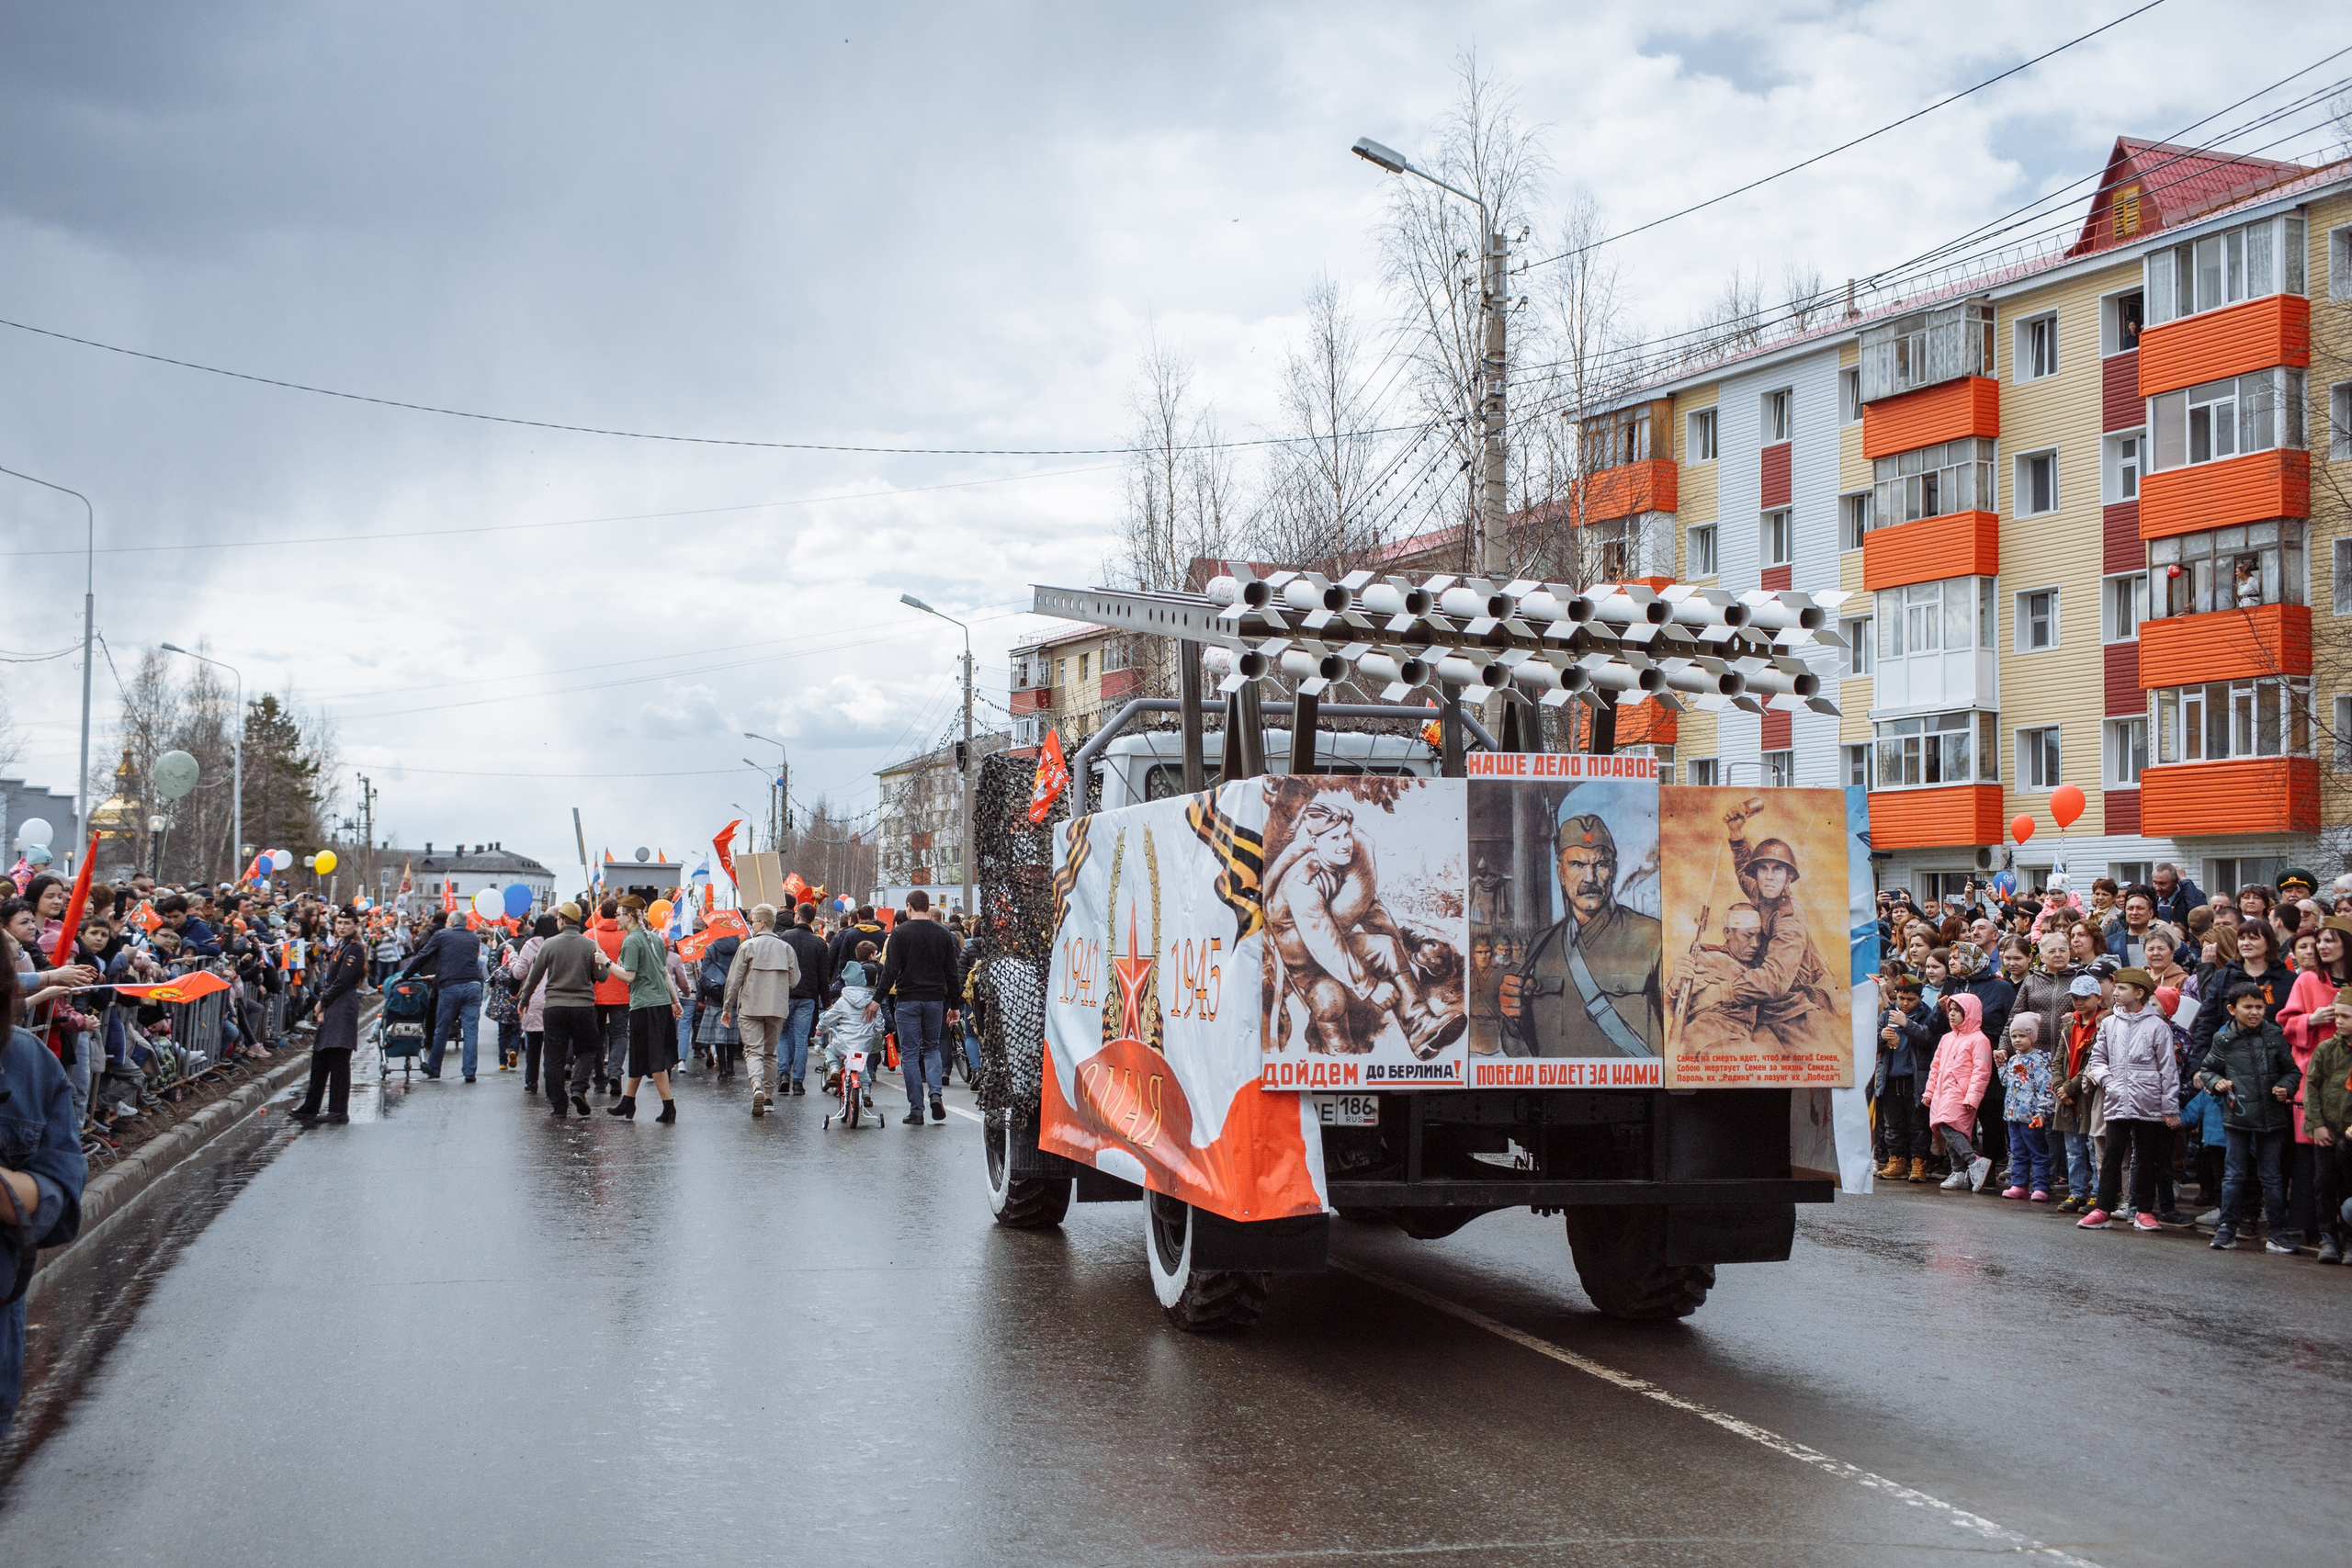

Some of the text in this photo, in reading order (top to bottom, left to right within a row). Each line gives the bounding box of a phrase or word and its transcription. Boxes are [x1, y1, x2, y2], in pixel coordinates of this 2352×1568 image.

[1467, 754, 1658, 778] НАШЕ ДЕЛО ПРАВОЕ
[1058, 937, 1099, 1008] 1941
[1170, 937, 1222, 1022] 1945
[1365, 1065, 1385, 1079] ДО
[1388, 1059, 1461, 1079] БЕРЛИНА!
[1677, 1055, 1699, 1063] Самед
[1712, 1055, 1738, 1064] смерть
[1739, 1055, 1759, 1063] идет,
[1761, 1054, 1780, 1062] чтоб
[1792, 1054, 1814, 1062] погиб
[1815, 1054, 1840, 1063] Семен,
[1677, 1064, 1701, 1072] Собою
[1704, 1064, 1740, 1073] жертвует
[1745, 1064, 1767, 1072] Семен
[1769, 1064, 1778, 1072] за
[1781, 1064, 1804, 1072] жизнь
[1476, 1063, 1660, 1087] ПОБЕДА БУДЕТ ЗА НАМИ
[1677, 1074, 1703, 1082] Пароль
[1706, 1074, 1715, 1082] их
[1764, 1074, 1788, 1083] лозунг
[1791, 1074, 1800, 1082] их
[1081, 1062, 1163, 1149] 9 МАЯ
[1340, 1097, 1373, 1115] 186
